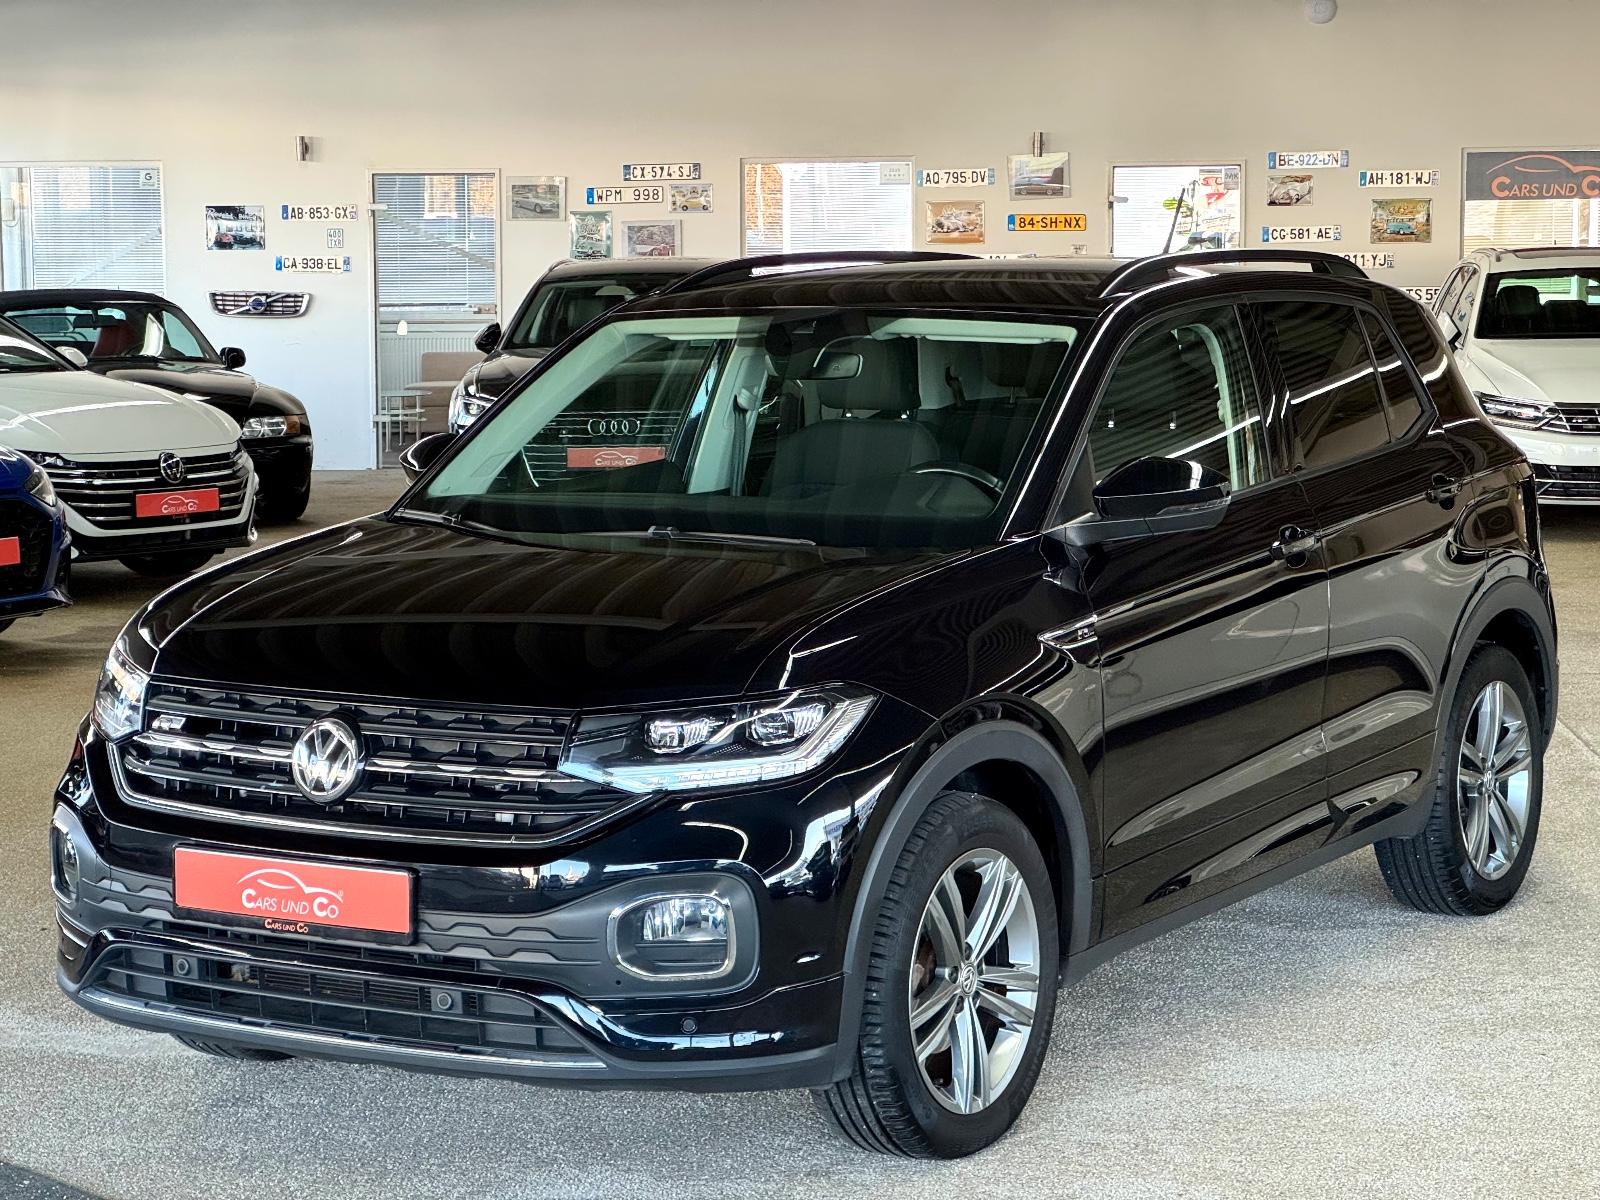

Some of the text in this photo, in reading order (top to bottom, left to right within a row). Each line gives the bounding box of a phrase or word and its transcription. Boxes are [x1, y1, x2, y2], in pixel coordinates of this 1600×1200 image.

[631, 165, 692, 179] CX-574-SJ
[924, 170, 987, 185] AQ-795-DV
[1367, 171, 1431, 185] AH-181-WJ
[1491, 176, 1539, 198] CARS
[1542, 183, 1577, 197] UND
[596, 188, 660, 203] WPM 998
[290, 206, 349, 220] AB-853-GX
[1018, 216, 1082, 229] 84-SH-NX
[283, 257, 342, 270] CA-938-EL
[241, 888, 277, 912] CARS
[281, 899, 310, 915] UND
